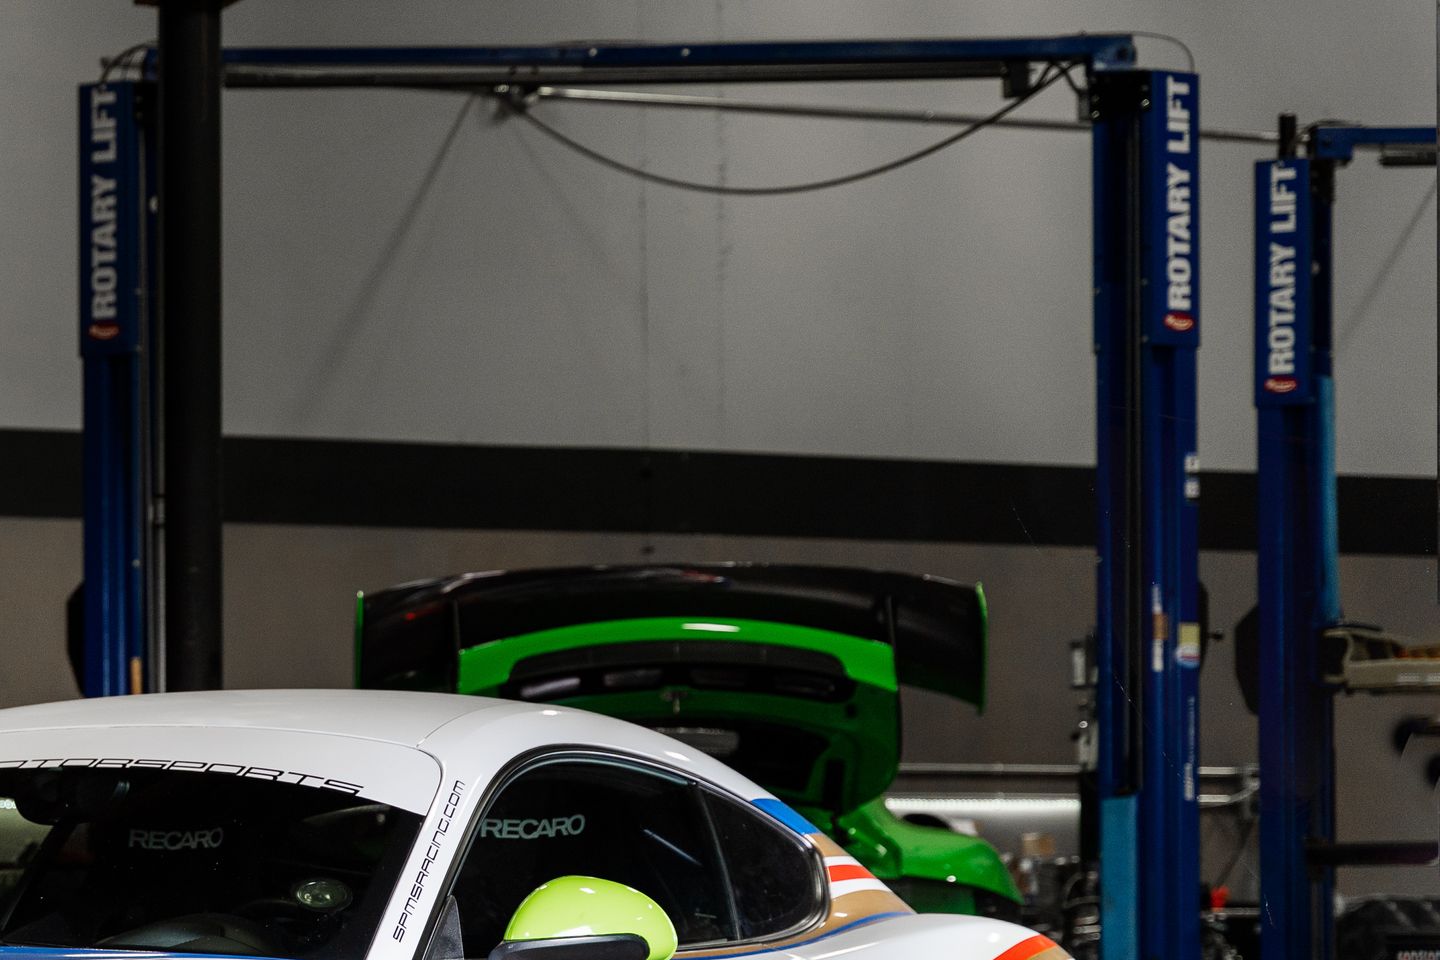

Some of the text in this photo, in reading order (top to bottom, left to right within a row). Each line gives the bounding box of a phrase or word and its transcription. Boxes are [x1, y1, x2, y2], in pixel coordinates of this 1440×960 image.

[91, 86, 118, 164] LIFT
[1166, 74, 1191, 154] LIFT
[1166, 161, 1192, 311] ROTARY
[1269, 163, 1297, 234] LIFT
[91, 174, 118, 320] ROTARY
[1267, 242, 1296, 375] ROTARY
[127, 826, 224, 851] RECARO
[479, 813, 586, 840] RECARO
